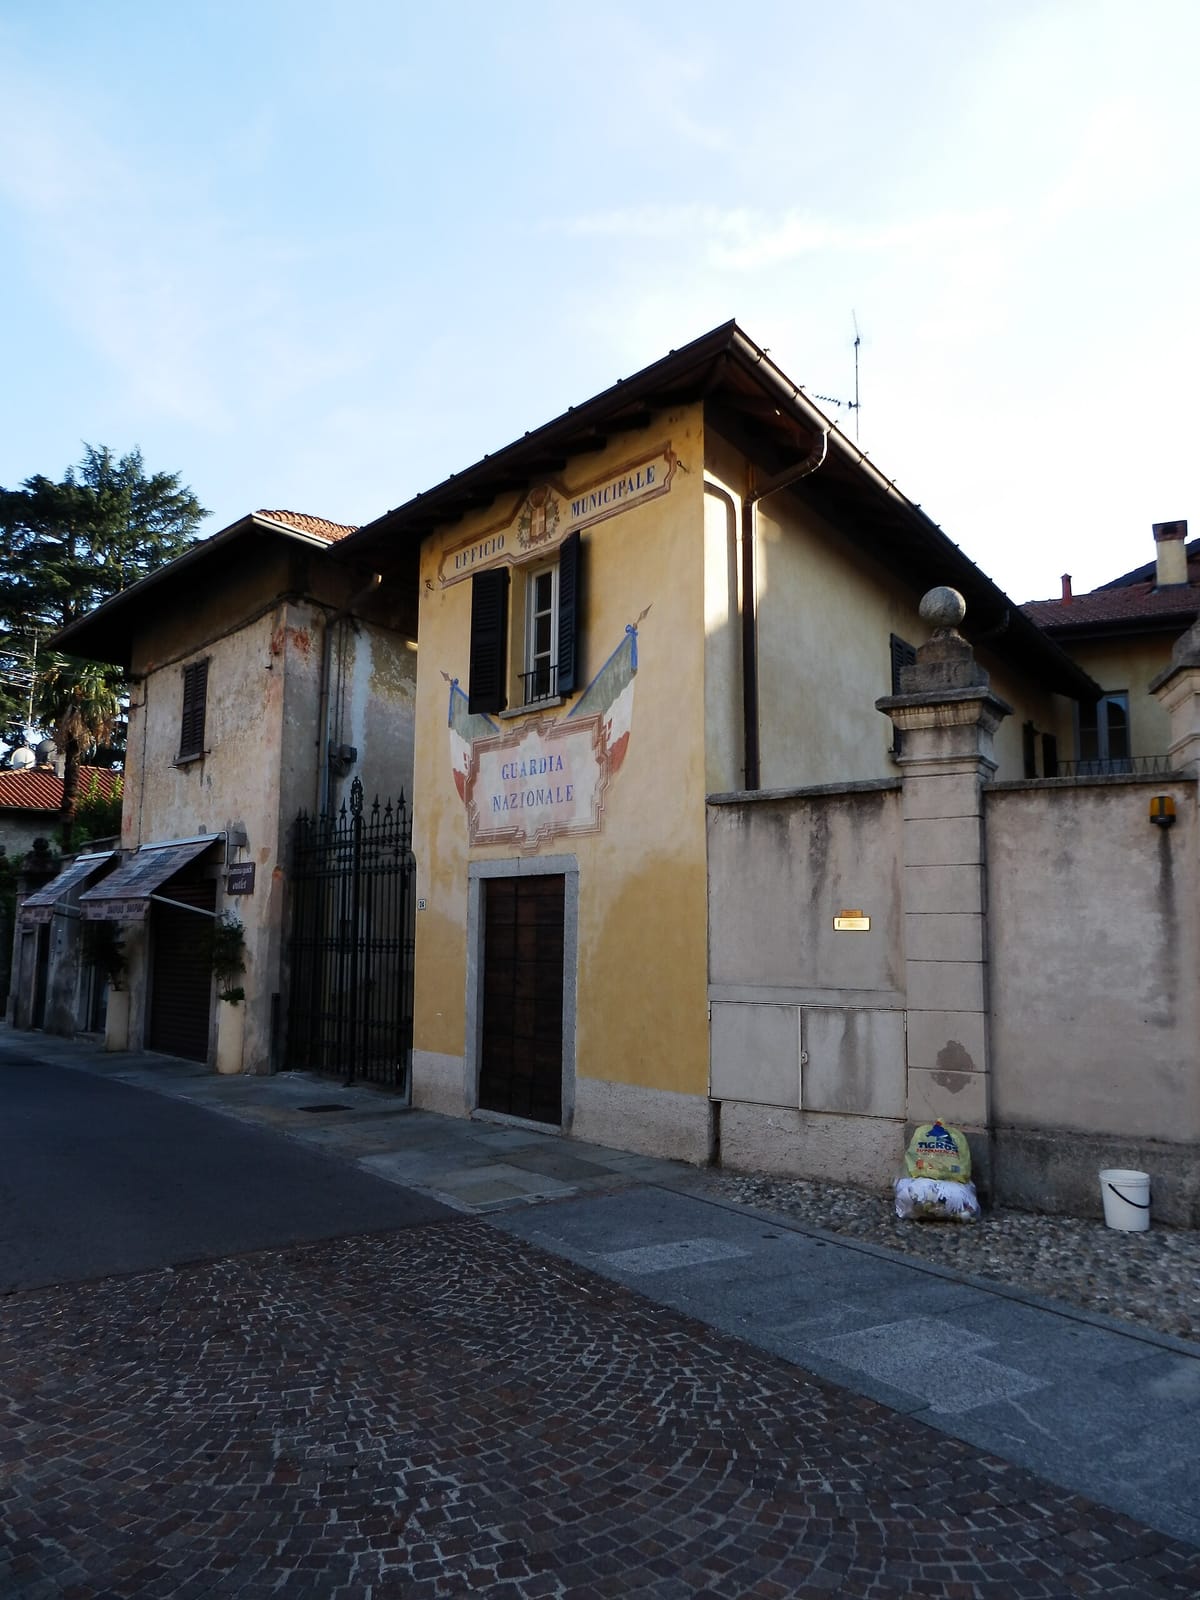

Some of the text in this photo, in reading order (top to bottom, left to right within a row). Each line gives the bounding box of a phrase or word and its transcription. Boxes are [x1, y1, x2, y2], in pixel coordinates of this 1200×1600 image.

[455, 465, 656, 569] UFFICIO MUNICIPALE
[502, 755, 564, 780] GUARDIA
[493, 785, 574, 812] NAZIONALE
[918, 1141, 959, 1153] TIGROS
